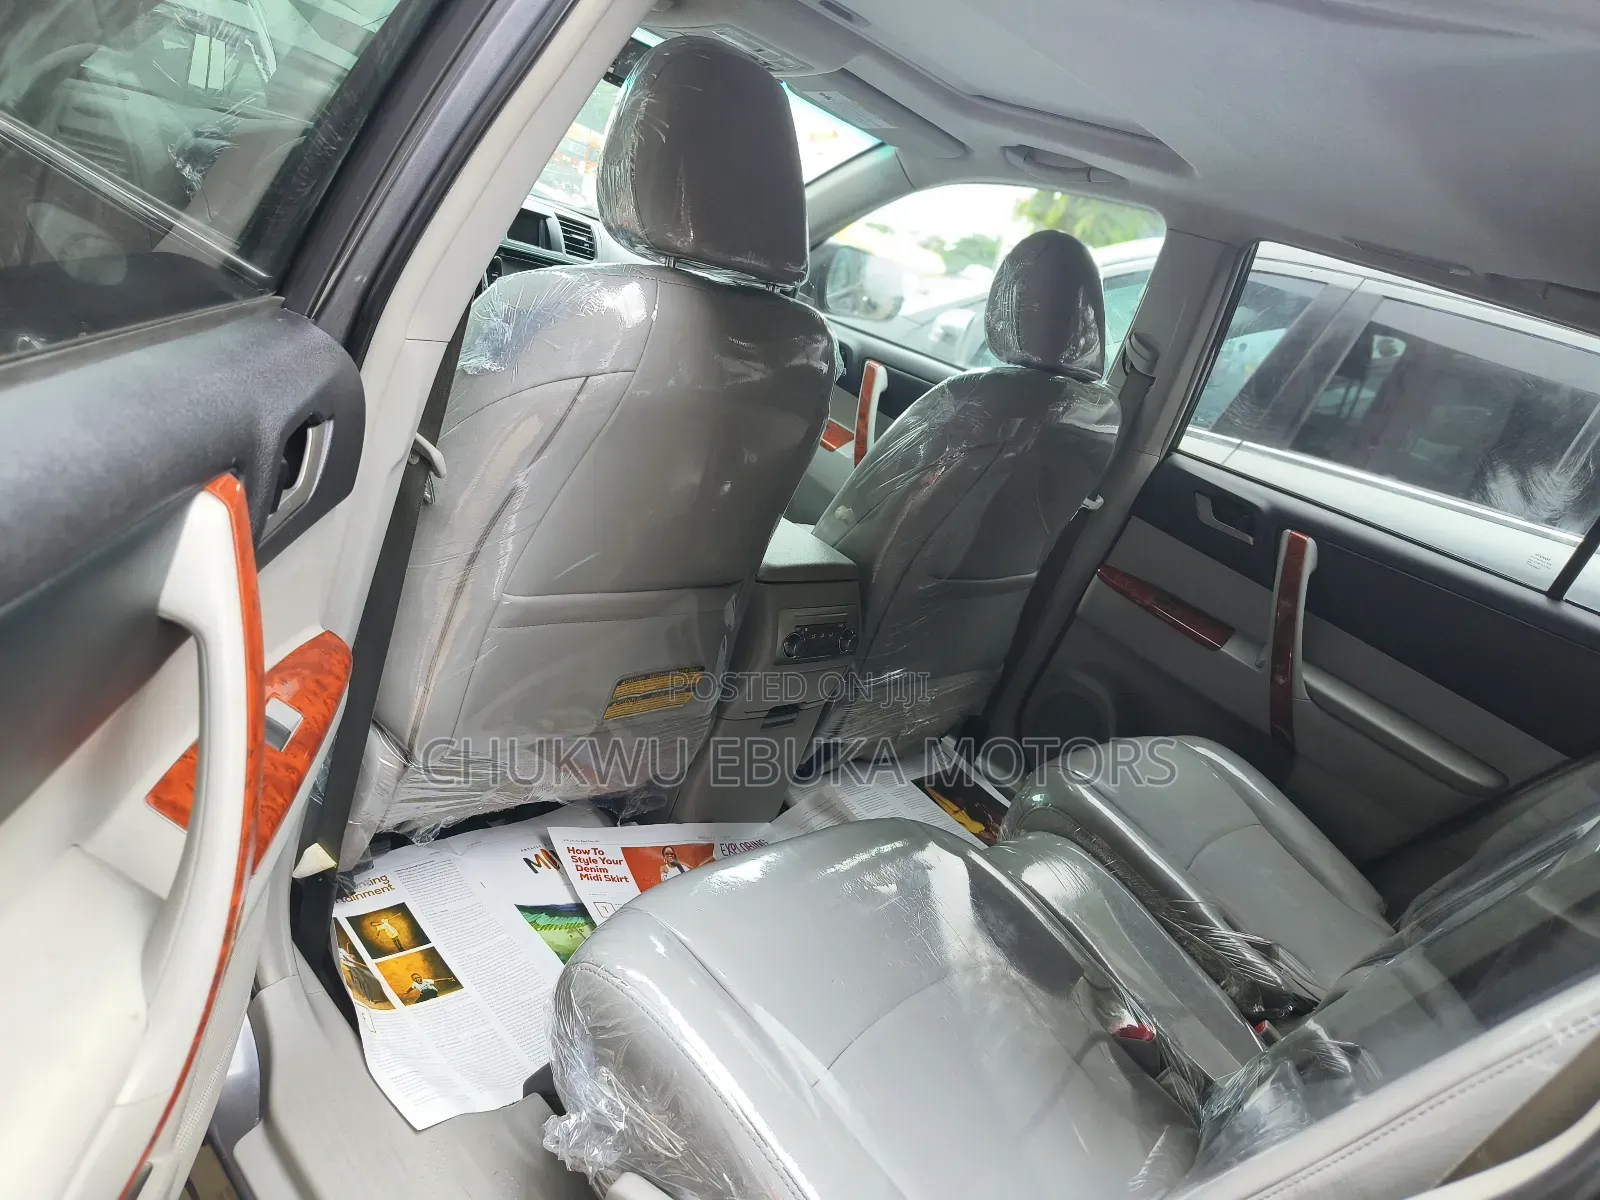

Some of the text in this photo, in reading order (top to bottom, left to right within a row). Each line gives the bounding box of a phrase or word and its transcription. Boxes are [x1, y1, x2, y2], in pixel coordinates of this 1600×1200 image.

[566, 846, 605, 856] How To
[571, 855, 624, 866] Style Your
[575, 864, 609, 874] Denim
[579, 873, 630, 883] Midi Skirt
